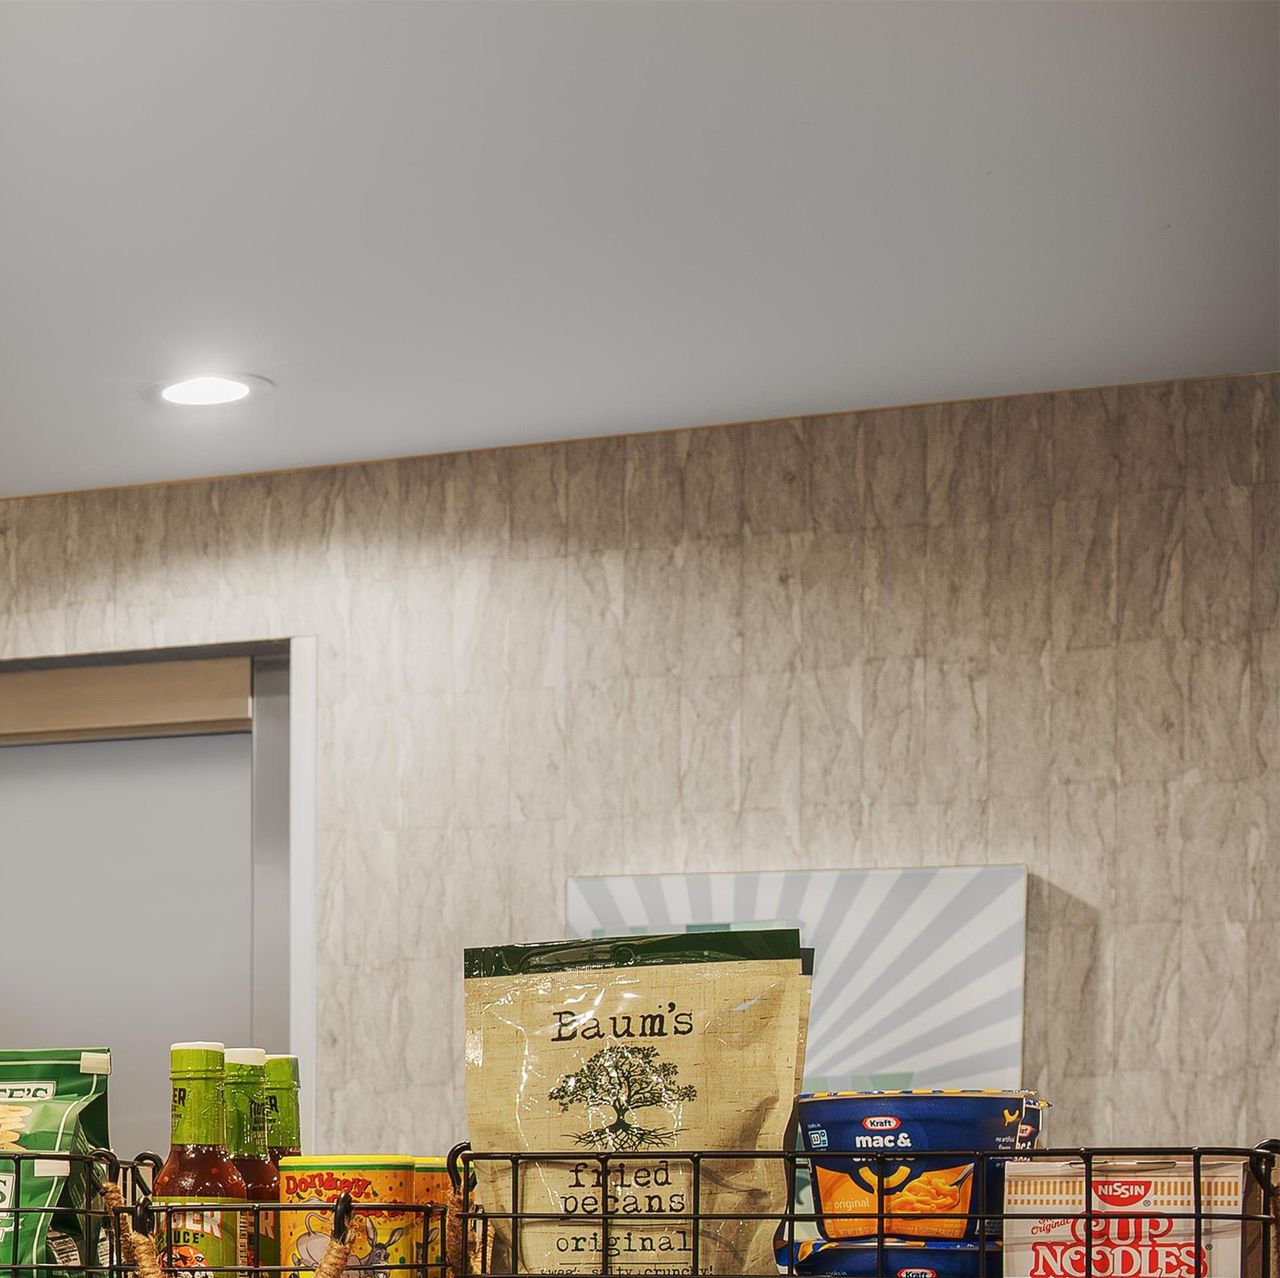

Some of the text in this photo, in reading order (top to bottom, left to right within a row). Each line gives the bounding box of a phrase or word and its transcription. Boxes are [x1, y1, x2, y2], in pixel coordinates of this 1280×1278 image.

[551, 1002, 693, 1042] Baum's
[869, 1119, 892, 1128] Kraft
[855, 1132, 912, 1148] mac &
[568, 1160, 670, 1188] fried
[1098, 1183, 1144, 1196] NISSIN
[559, 1192, 685, 1220] pecans
[834, 1198, 869, 1209] original
[556, 1231, 693, 1256] original
[1035, 1245, 1206, 1276] NOODLES
